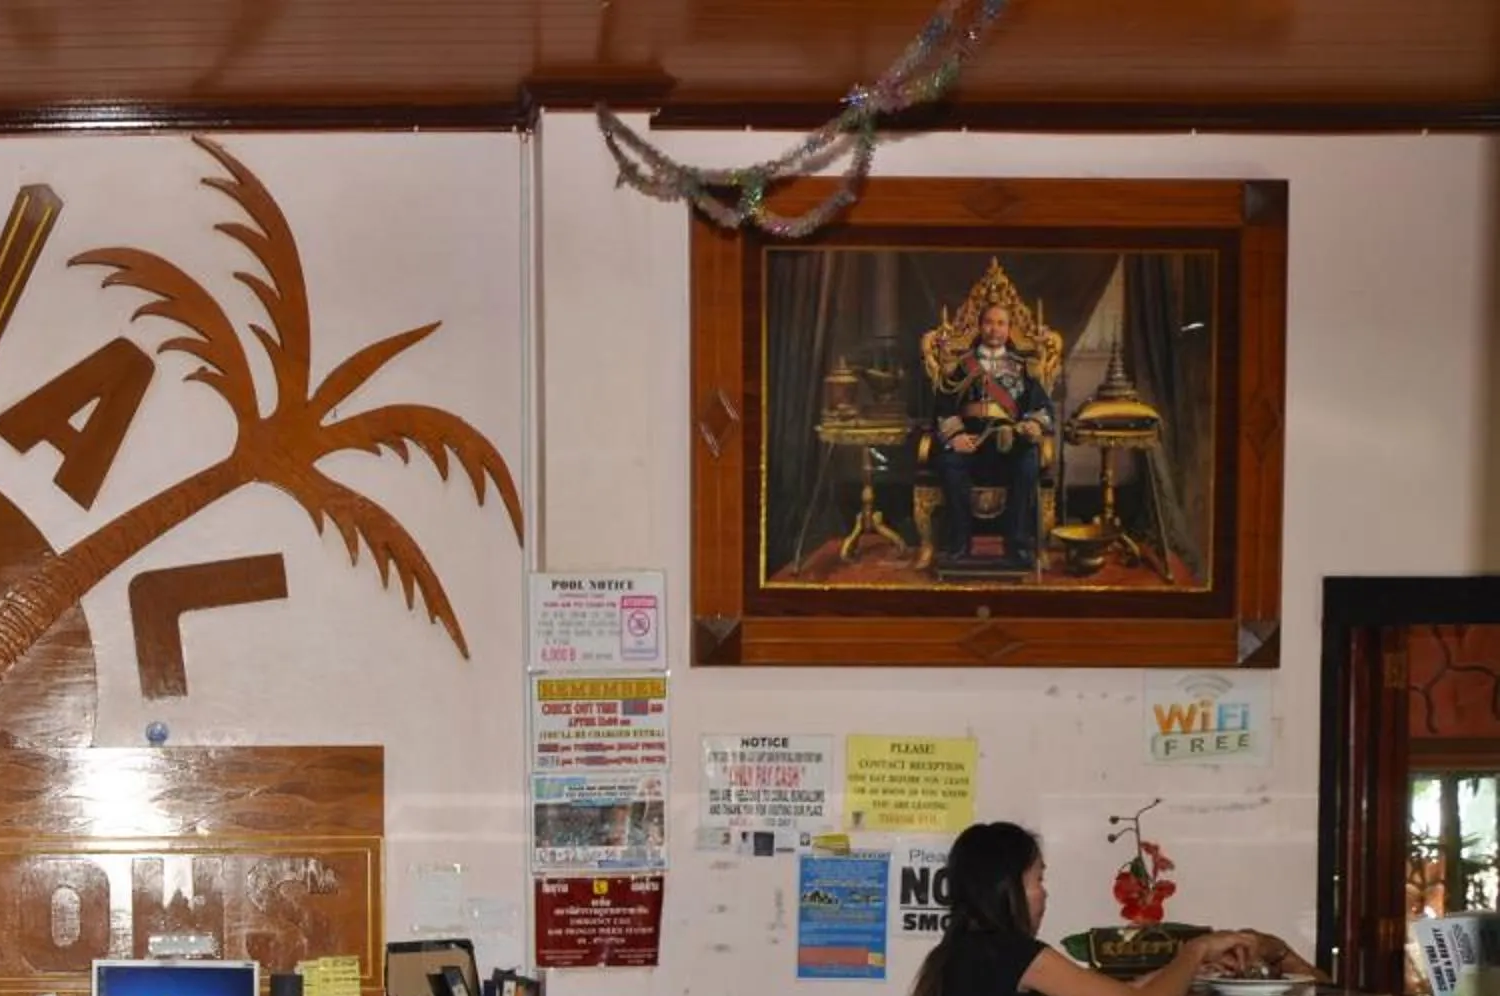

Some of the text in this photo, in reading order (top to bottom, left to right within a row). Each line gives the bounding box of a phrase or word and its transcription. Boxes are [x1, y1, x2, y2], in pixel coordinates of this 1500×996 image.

[551, 580, 635, 590] POOL NOTICE
[1153, 699, 1250, 735] WiFi
[741, 737, 789, 748] NOTICE
[1163, 734, 1250, 756] FREE
[858, 759, 965, 771] CONTACT RECEPTION
[903, 913, 951, 931] SMO
